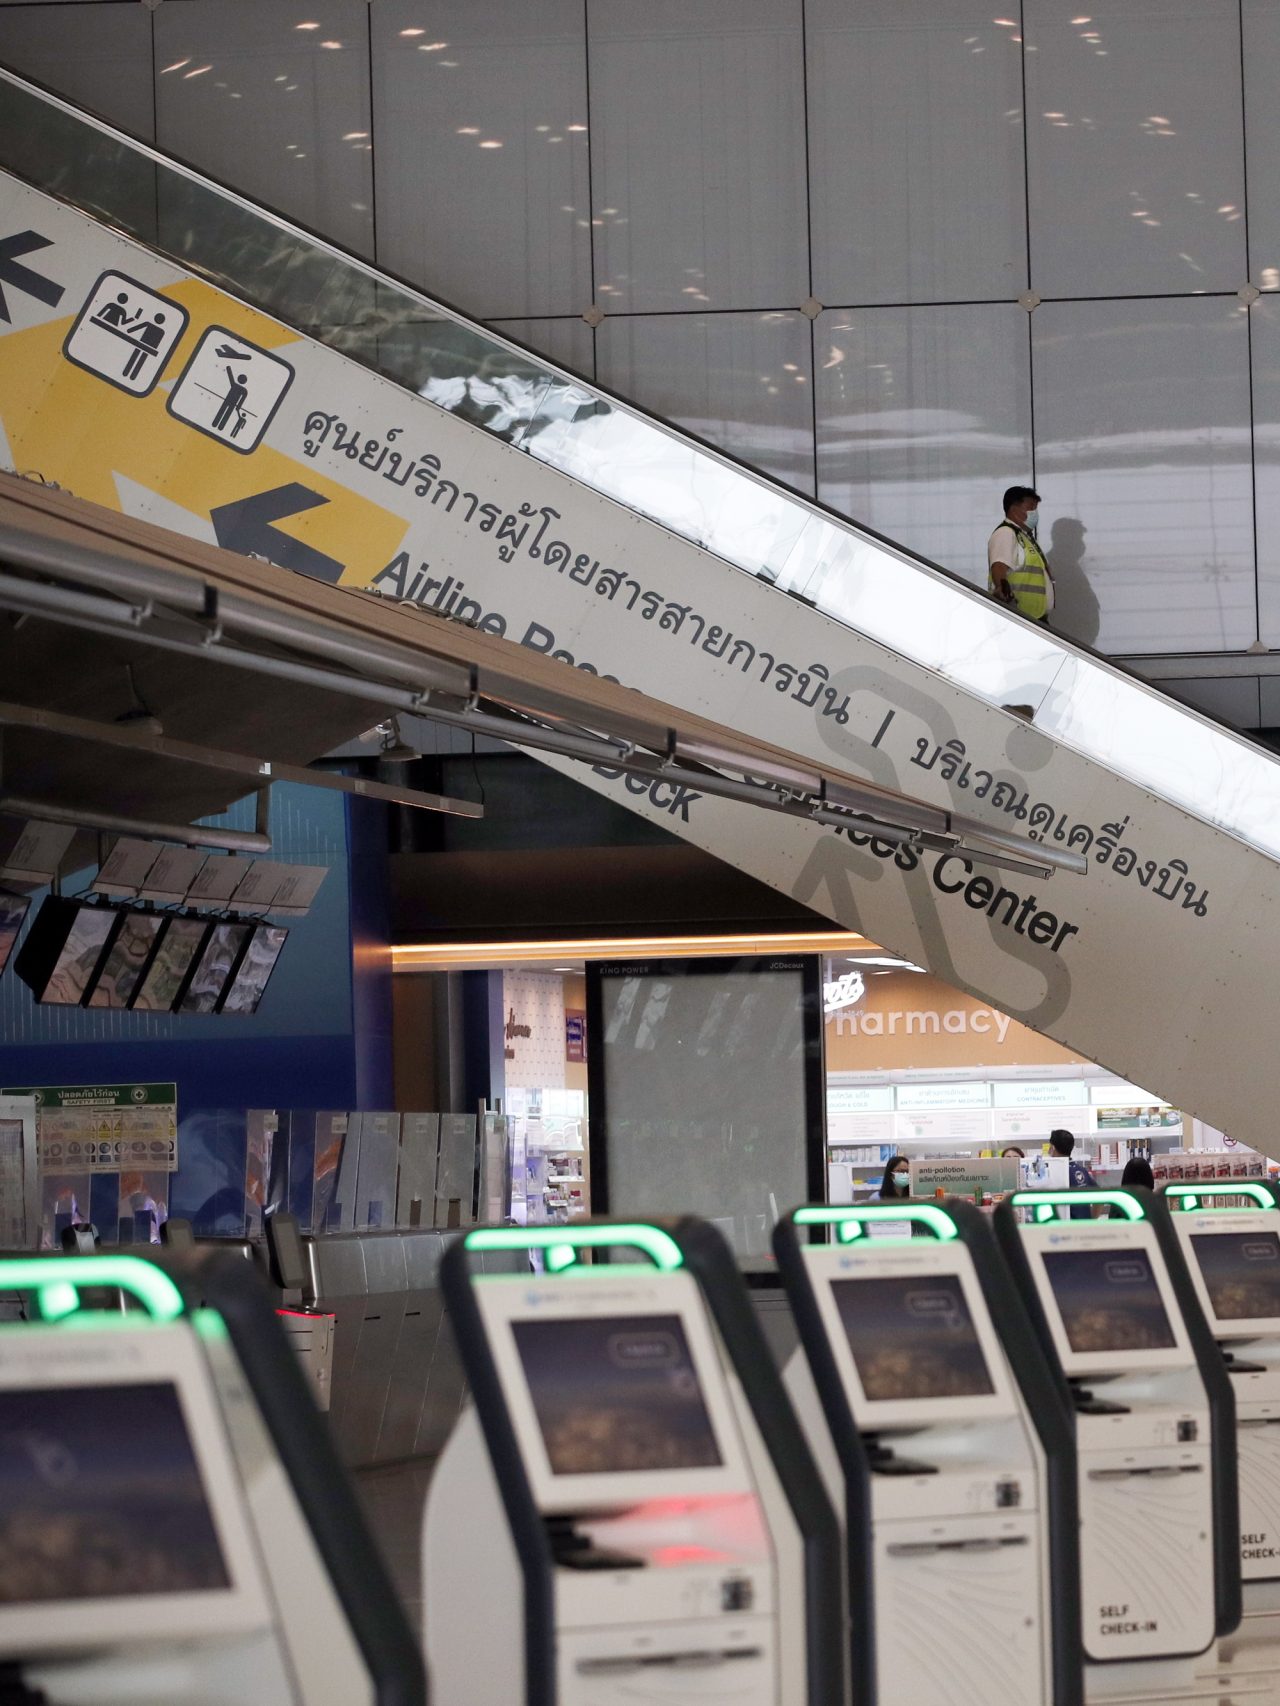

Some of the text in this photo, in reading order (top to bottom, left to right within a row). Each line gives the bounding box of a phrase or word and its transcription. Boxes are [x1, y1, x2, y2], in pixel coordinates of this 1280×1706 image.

[303, 411, 851, 725] ศูนย์บริการผู้โดยสารสายการบิน
[910, 736, 1208, 917] บริเวณดูเครื่องบิน
[933, 855, 1079, 953] Center
[1242, 1533, 1266, 1544] SELF
[1100, 1604, 1129, 1618] SELF
[1100, 1621, 1158, 1635] CHECK-IN
